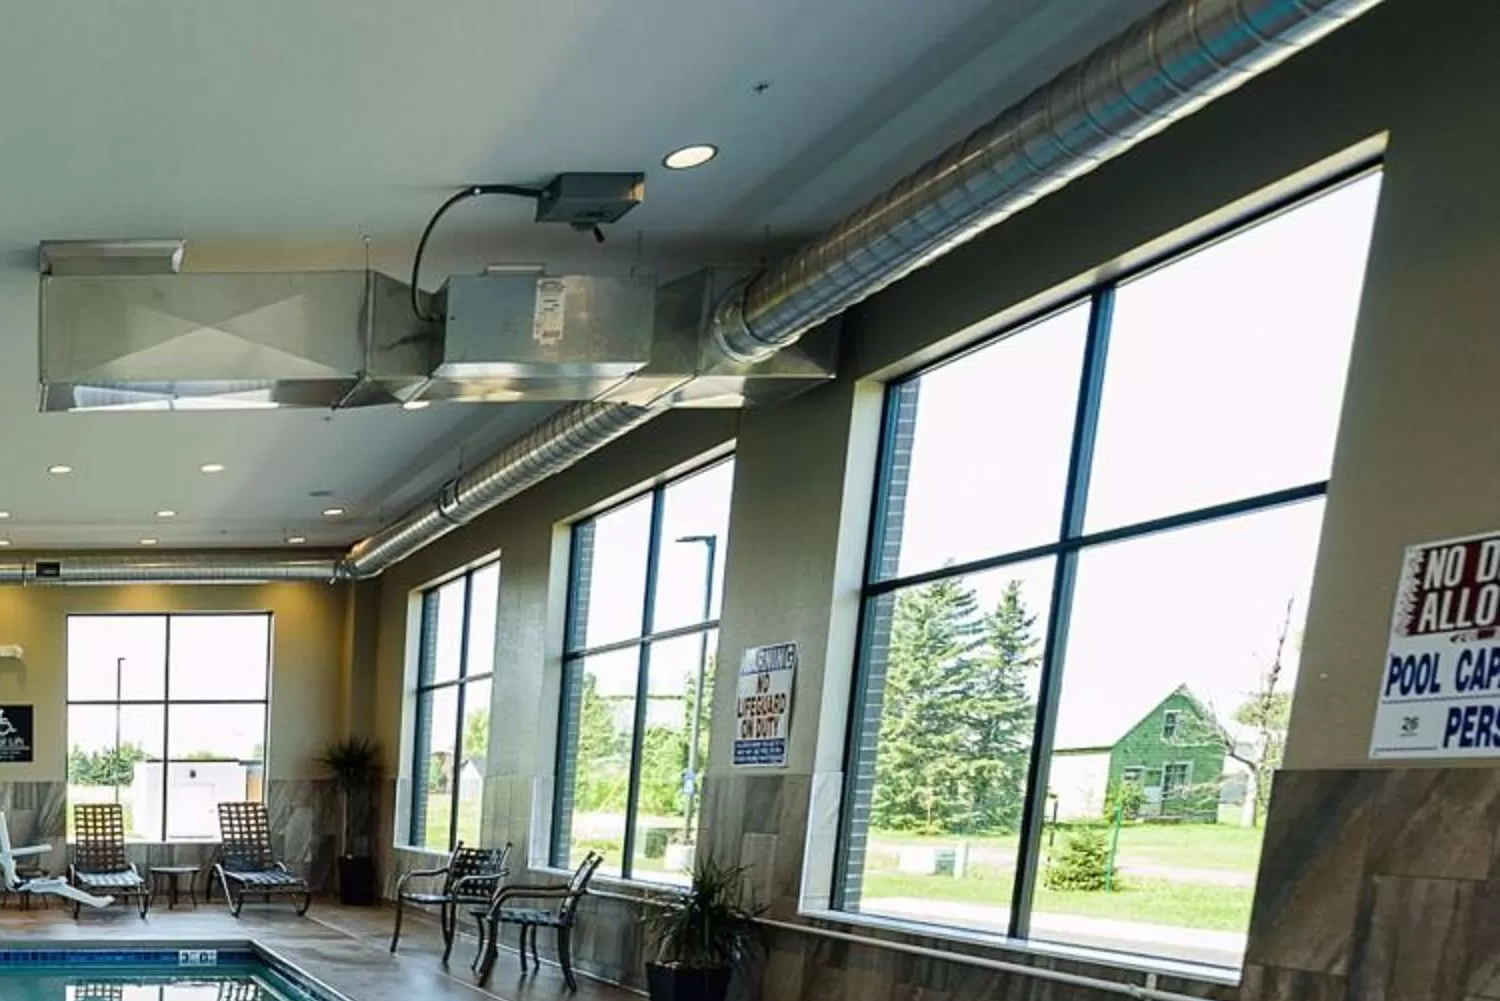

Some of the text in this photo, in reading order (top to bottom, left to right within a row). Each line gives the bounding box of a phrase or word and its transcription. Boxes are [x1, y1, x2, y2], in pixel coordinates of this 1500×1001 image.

[1423, 541, 1500, 590] NO D
[1417, 584, 1500, 632] ALLO
[1384, 647, 1500, 697] POOL CAP
[737, 693, 786, 718] LIFEGUARD
[741, 717, 778, 738] ON DUTY
